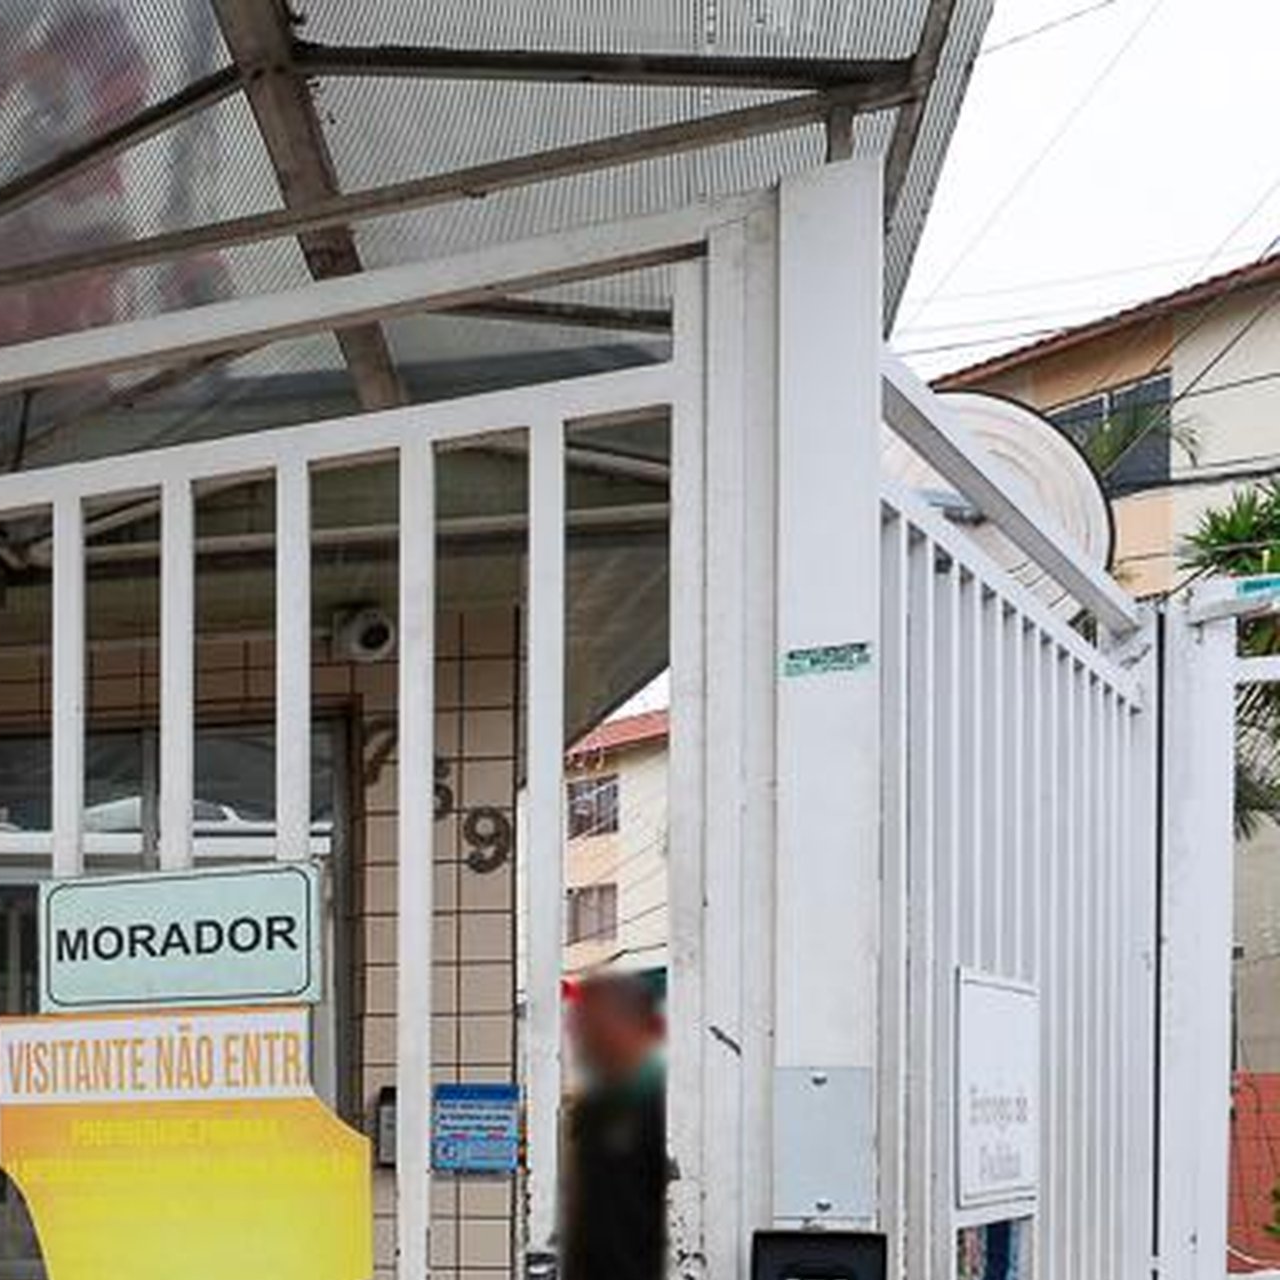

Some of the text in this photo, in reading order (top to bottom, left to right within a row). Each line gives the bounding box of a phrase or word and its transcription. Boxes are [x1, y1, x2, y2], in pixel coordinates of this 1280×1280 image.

[55, 914, 299, 962] MORADOR
[7, 1024, 311, 1095] VISITANTE NÃO ENTR
